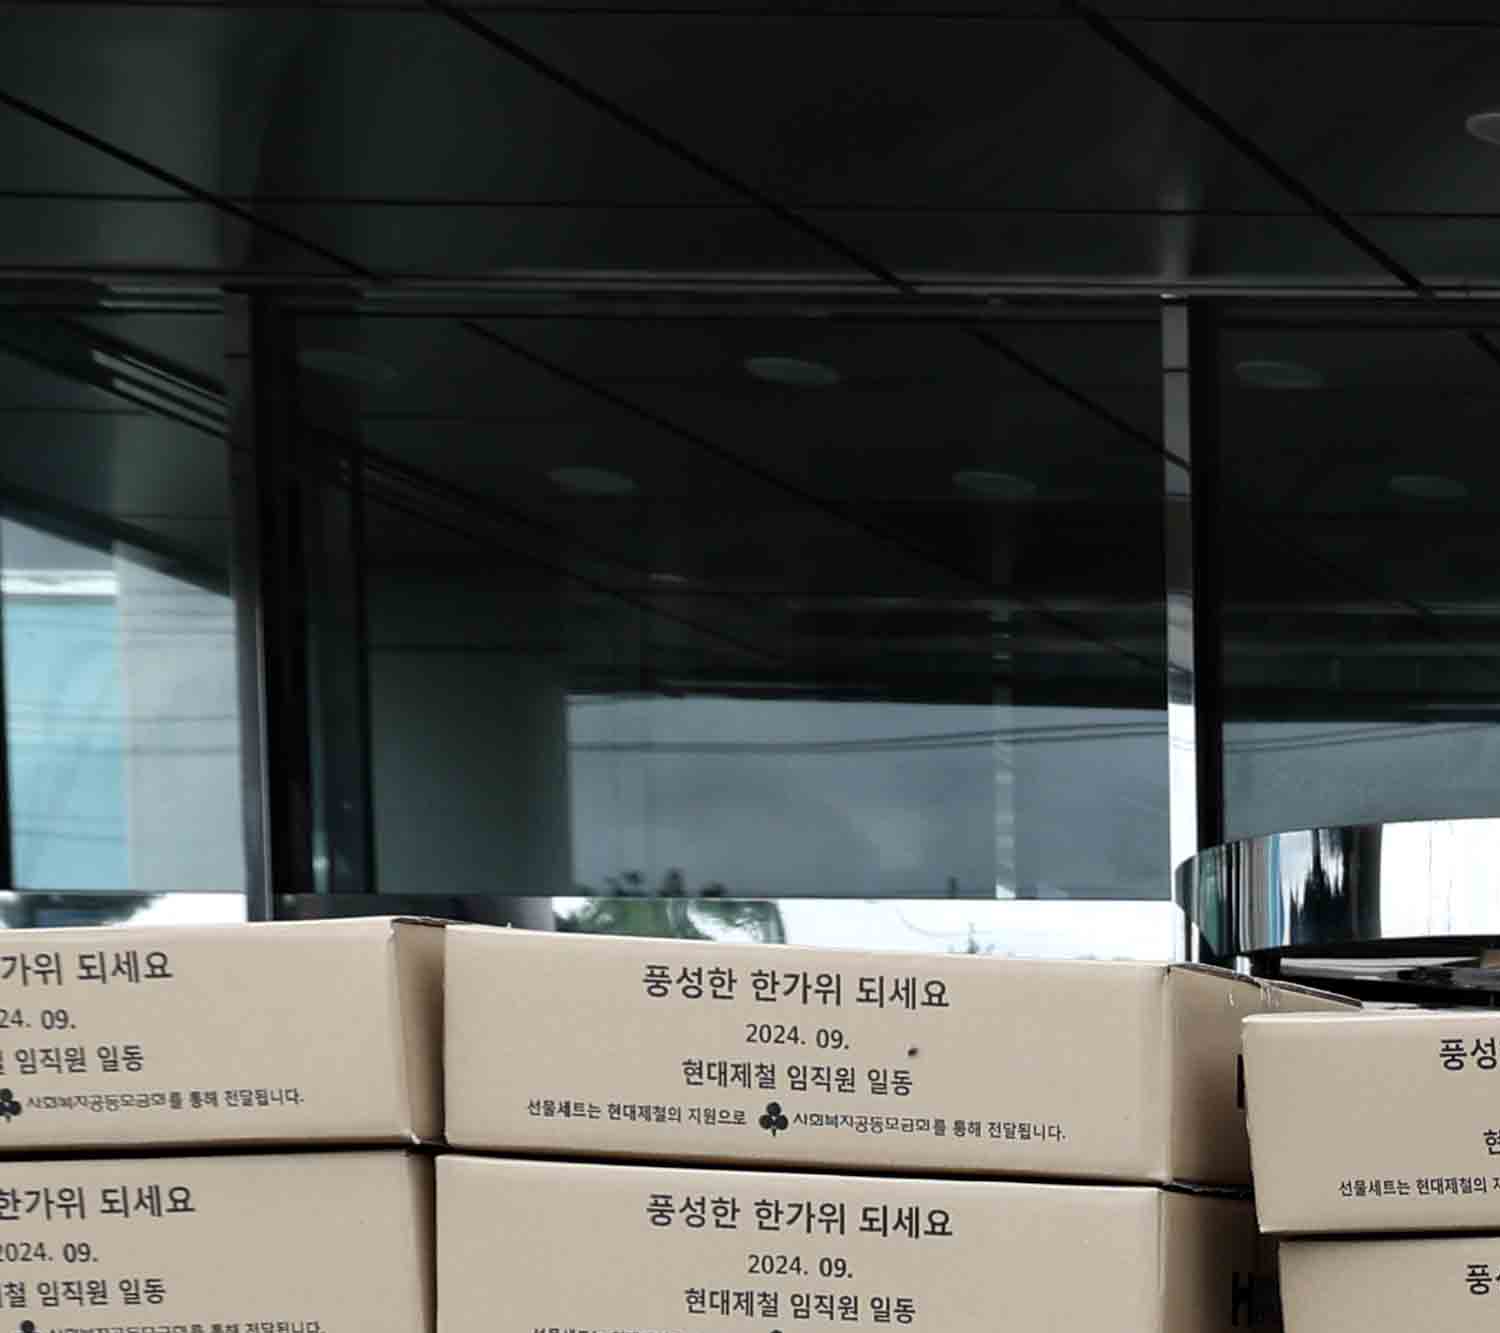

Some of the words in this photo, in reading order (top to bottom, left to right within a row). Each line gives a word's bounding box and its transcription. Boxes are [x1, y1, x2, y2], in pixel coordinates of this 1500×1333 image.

[641, 964, 739, 1001] 풍성한
[749, 968, 842, 1007] 한가위
[855, 975, 951, 1011] 되세요
[745, 1023, 807, 1046] 2024.
[815, 1028, 850, 1051] 09.
[681, 1058, 777, 1091] 현대제철
[786, 1064, 857, 1094] 임직원
[866, 1068, 913, 1097] 일동
[527, 1098, 602, 1120] 선물세트는
[606, 1103, 682, 1124] 현대제철의
[687, 1107, 748, 1126] 지원으로
[952, 1119, 982, 1138] 통해
[987, 1121, 1067, 1143] 전달됩니다.
[1338, 1178, 1411, 1198] 선물세트는
[1415, 1175, 1488, 1196] 현대제철의
